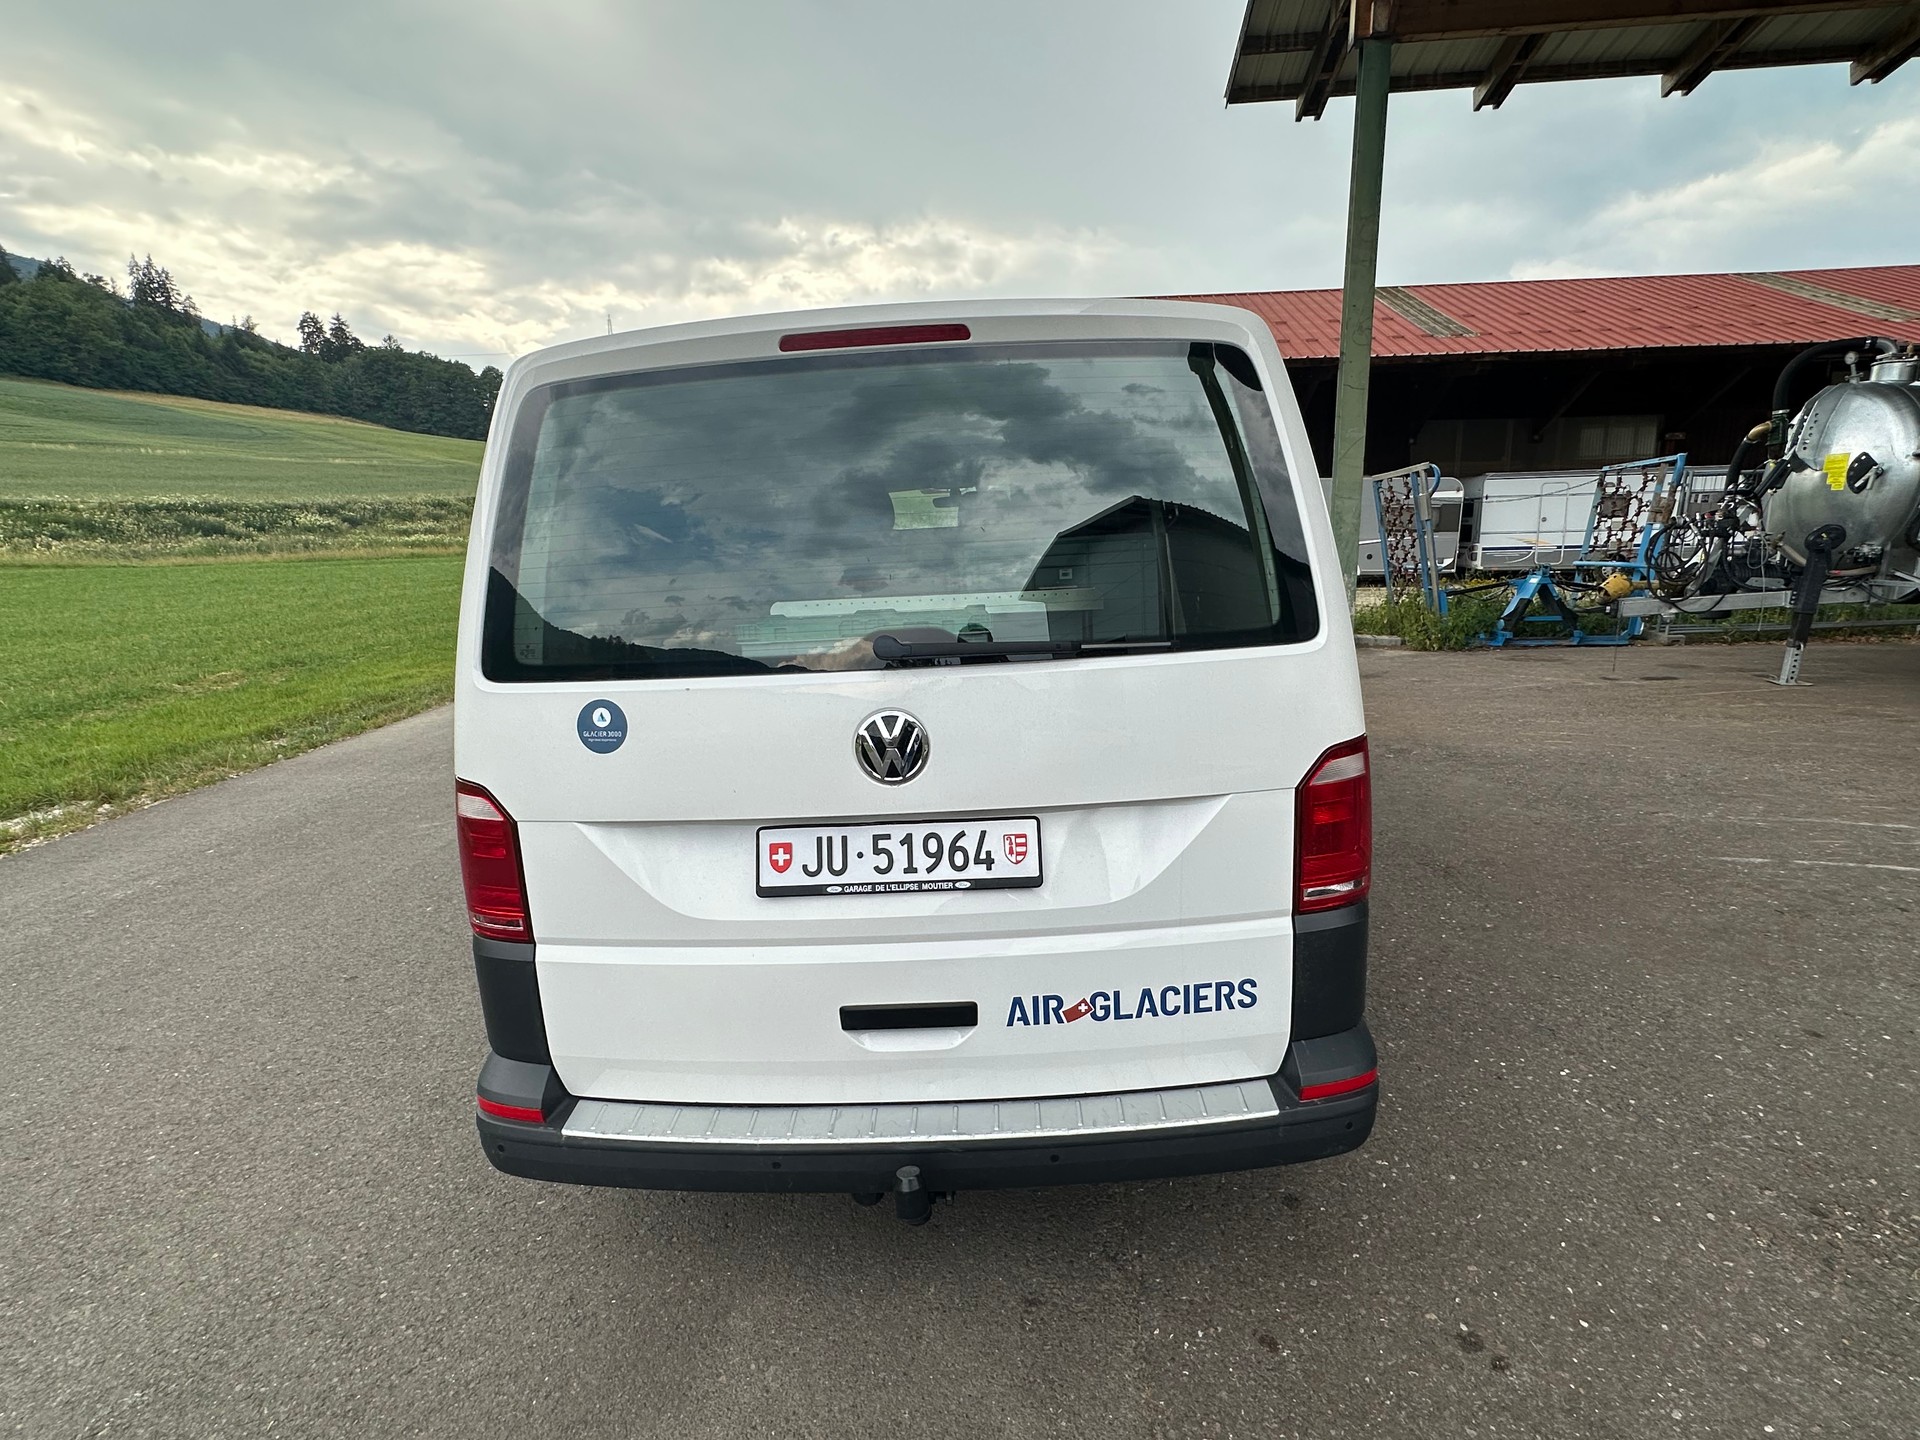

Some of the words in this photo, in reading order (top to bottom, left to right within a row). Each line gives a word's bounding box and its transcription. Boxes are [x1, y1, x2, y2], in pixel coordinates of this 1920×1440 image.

[583, 730, 607, 738] GLACIER
[843, 884, 873, 893] GARAGE
[875, 884, 885, 892] DE
[886, 883, 919, 891] L'ELLIPSE
[921, 882, 954, 890] MOUTIER
[1006, 994, 1065, 1027] AIR
[1089, 978, 1258, 1022] GLACIERS
